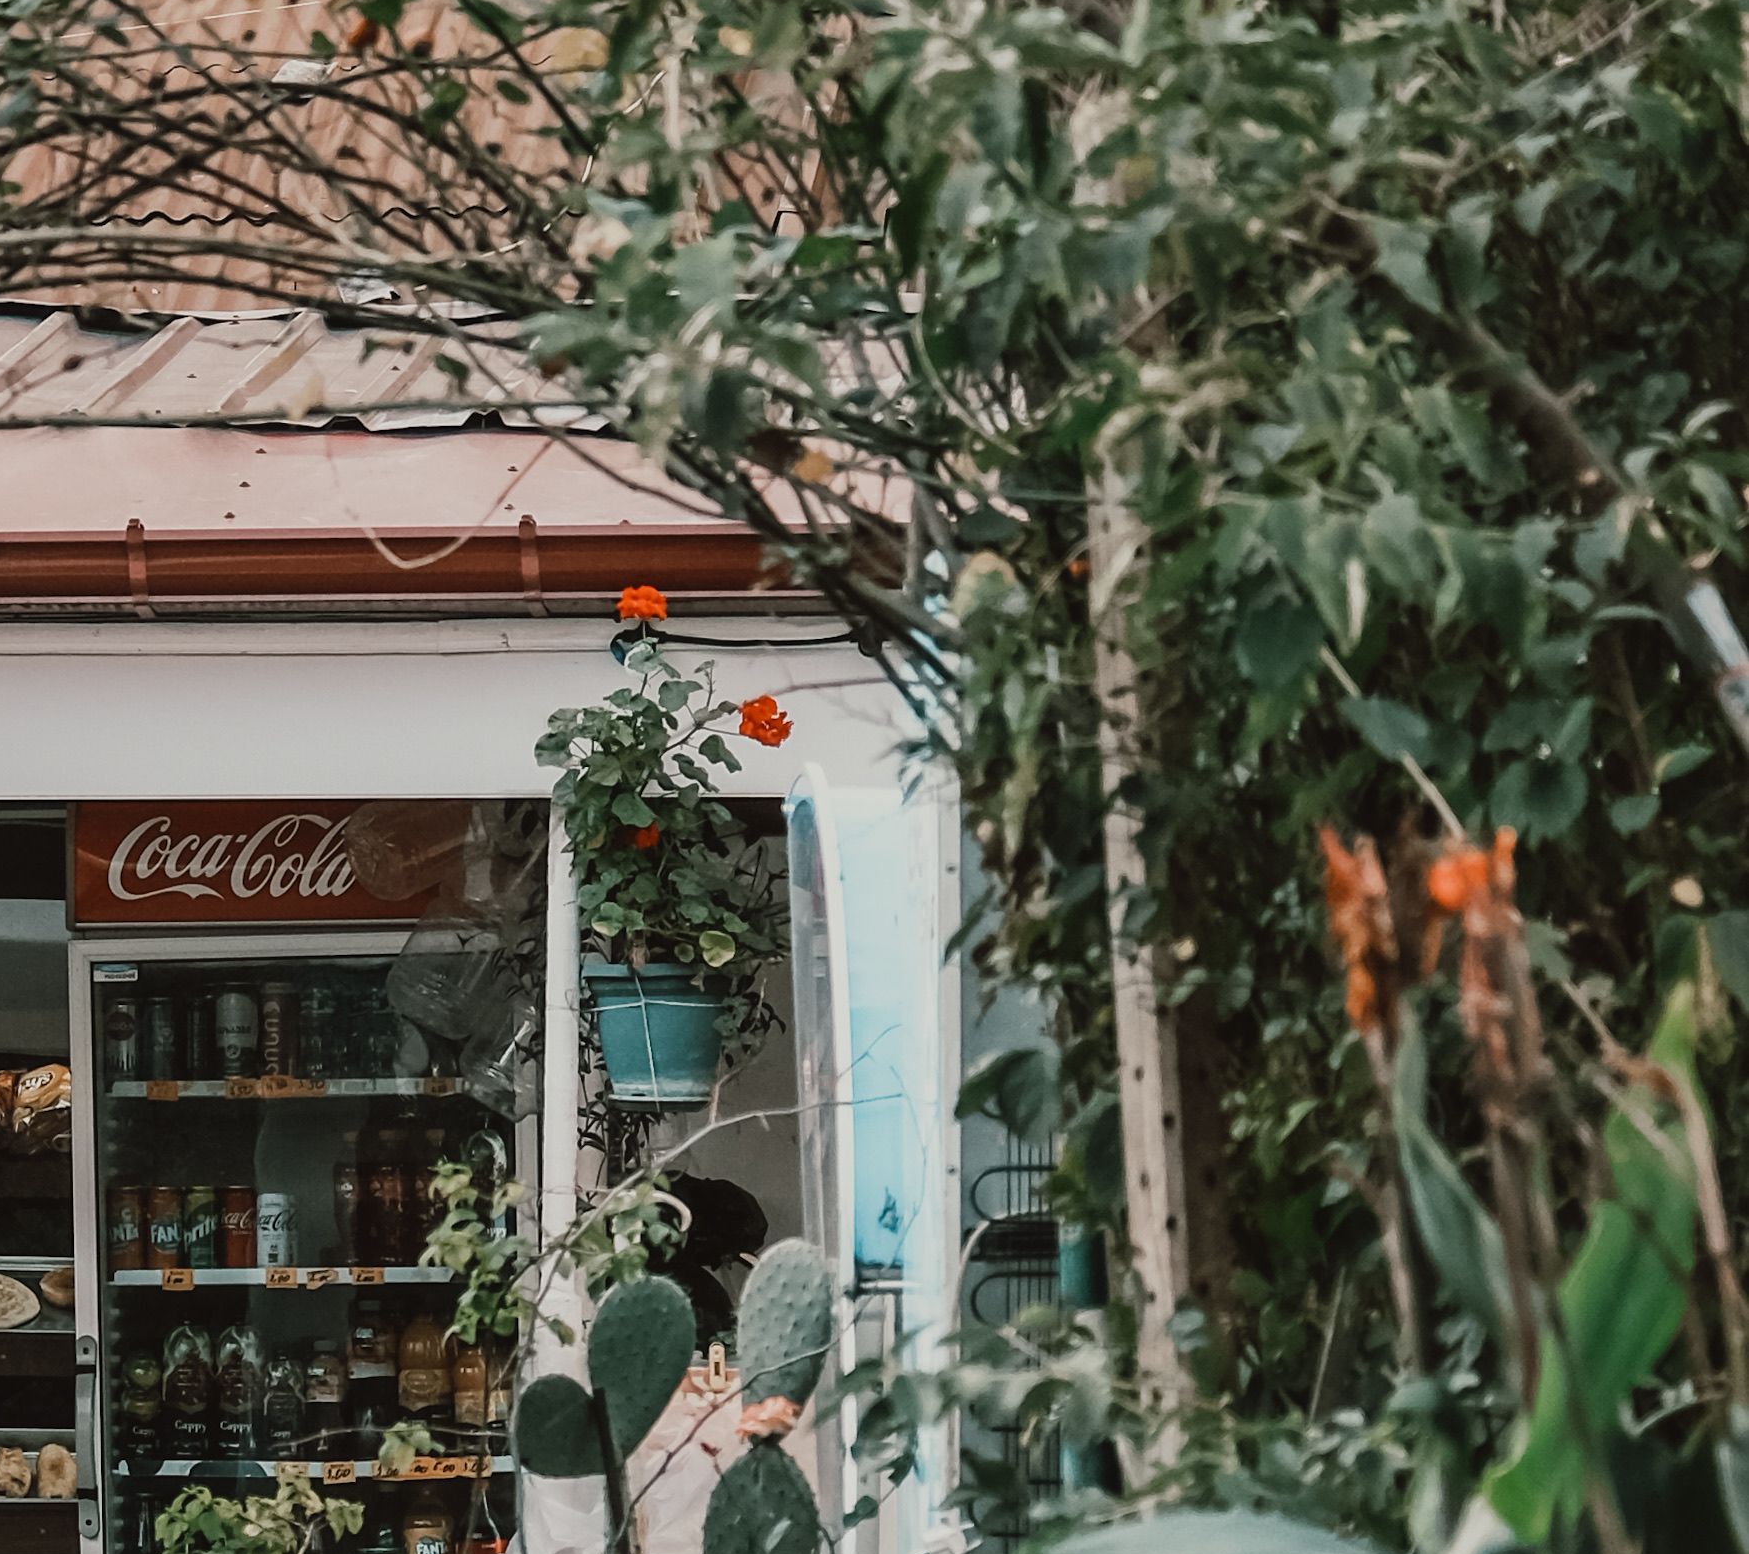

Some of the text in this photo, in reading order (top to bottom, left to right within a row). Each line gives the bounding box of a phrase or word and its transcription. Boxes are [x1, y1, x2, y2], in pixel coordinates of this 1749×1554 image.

[107, 814, 357, 901] Coca-Cola
[174, 1419, 207, 1435] Cappy
[219, 1420, 253, 1435] Cappy
